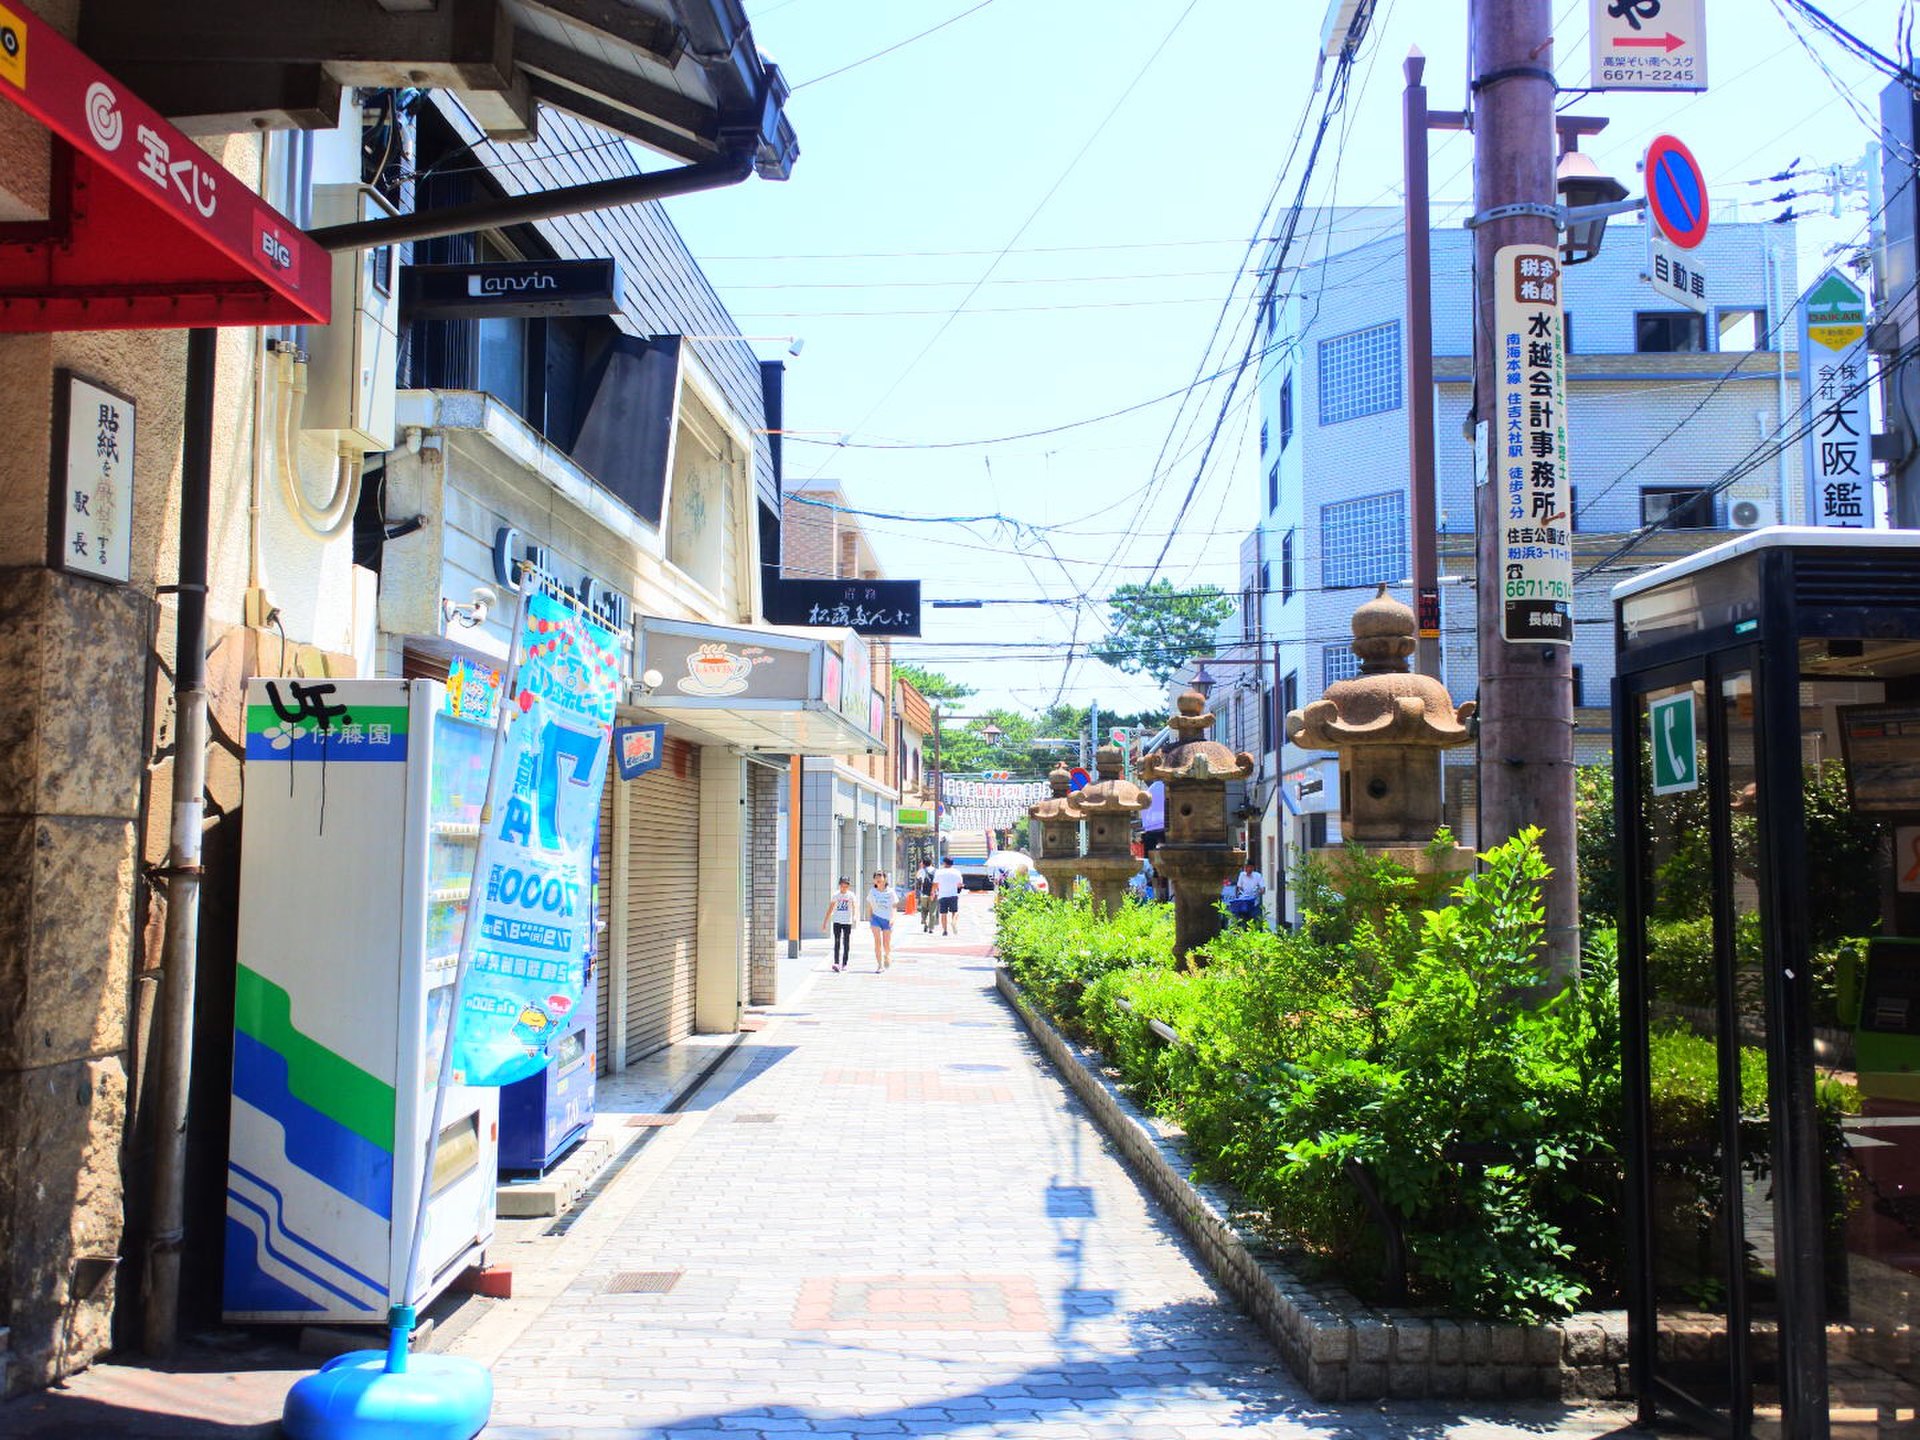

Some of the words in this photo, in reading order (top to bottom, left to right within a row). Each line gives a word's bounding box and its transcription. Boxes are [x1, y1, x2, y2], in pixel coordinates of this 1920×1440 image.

[1603, 69, 1695, 82] 6671-2245
[136, 124, 217, 218] 宝くじ
[467, 271, 558, 297] Lanvin
[1520, 258, 1554, 277] 税金
[1653, 252, 1706, 300] 自動車
[1506, 332, 1522, 385] 南海本線
[1507, 392, 1523, 458] 住吉大社駅
[1528, 311, 1556, 519] 水越会計事務所
[1821, 402, 1864, 527] 大阪鑑
[1508, 466, 1525, 519] 徒歩3分
[73, 490, 91, 556] 駅長
[311, 722, 391, 745] 伊藤園
